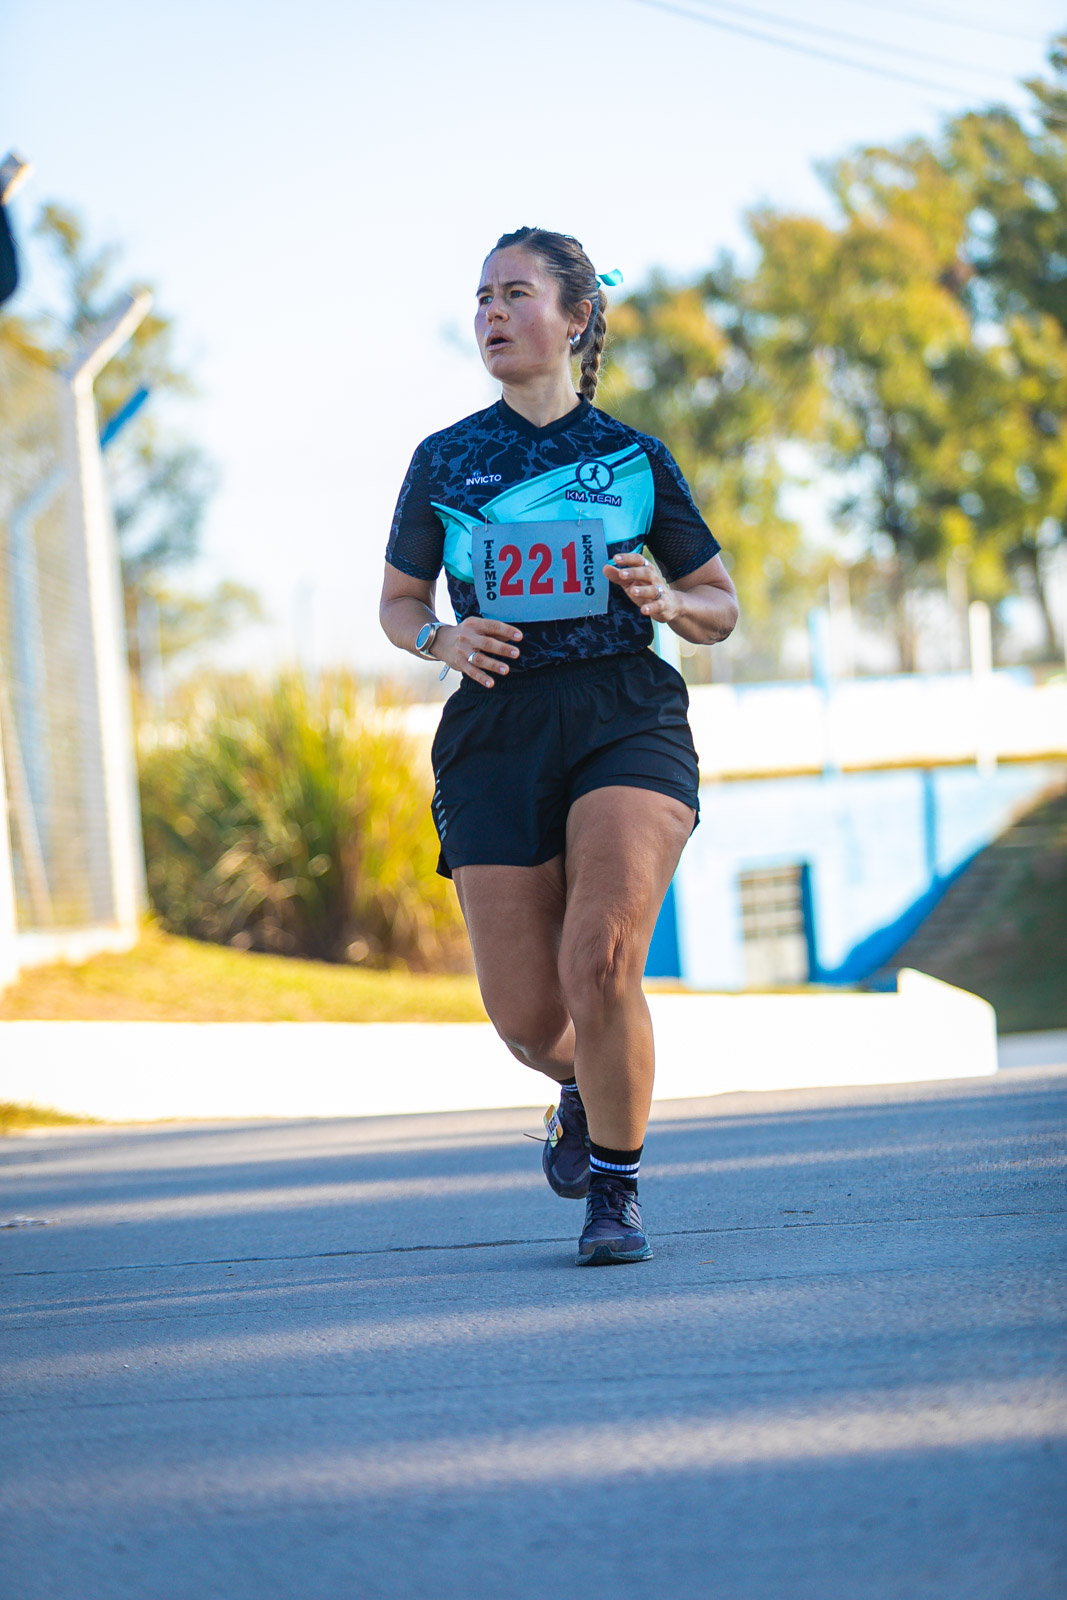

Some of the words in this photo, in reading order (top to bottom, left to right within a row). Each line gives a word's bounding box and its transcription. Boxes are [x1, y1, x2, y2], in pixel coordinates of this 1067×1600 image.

[466, 474, 502, 485] INVICTO
[589, 493, 621, 506] TEAM
[484, 540, 497, 601] TIEMPO
[498, 541, 581, 596] 221
[581, 535, 595, 596] EXACTO
